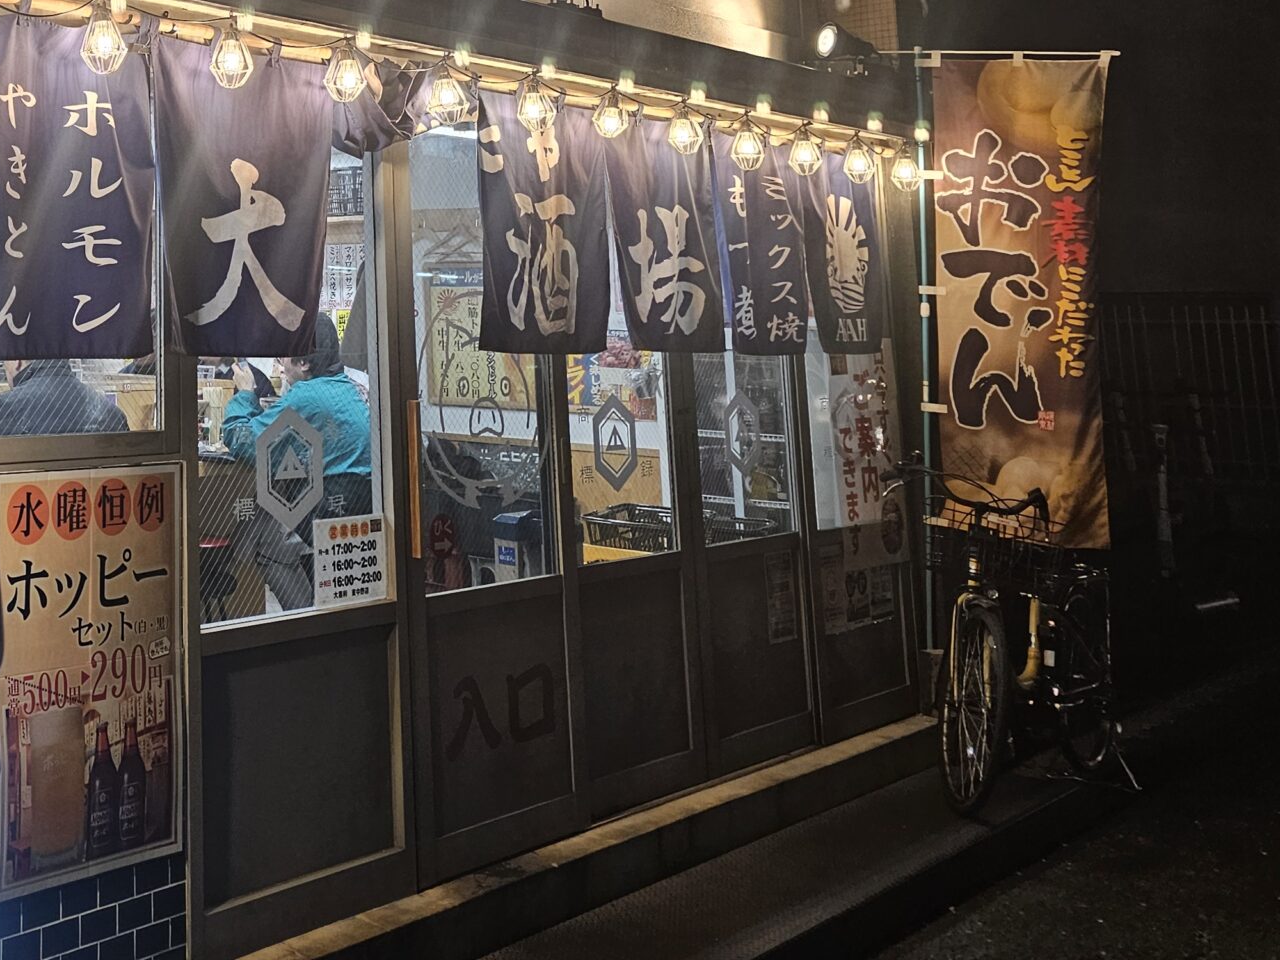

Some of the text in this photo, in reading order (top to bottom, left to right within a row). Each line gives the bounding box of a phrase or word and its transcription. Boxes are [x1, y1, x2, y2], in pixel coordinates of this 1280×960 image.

[61, 89, 124, 334] ホルモン
[183, 157, 307, 333] 大
[934, 127, 1055, 431] おでん
[6, 547, 169, 621] ホッピー
[11, 480, 165, 538] 水曜恒例
